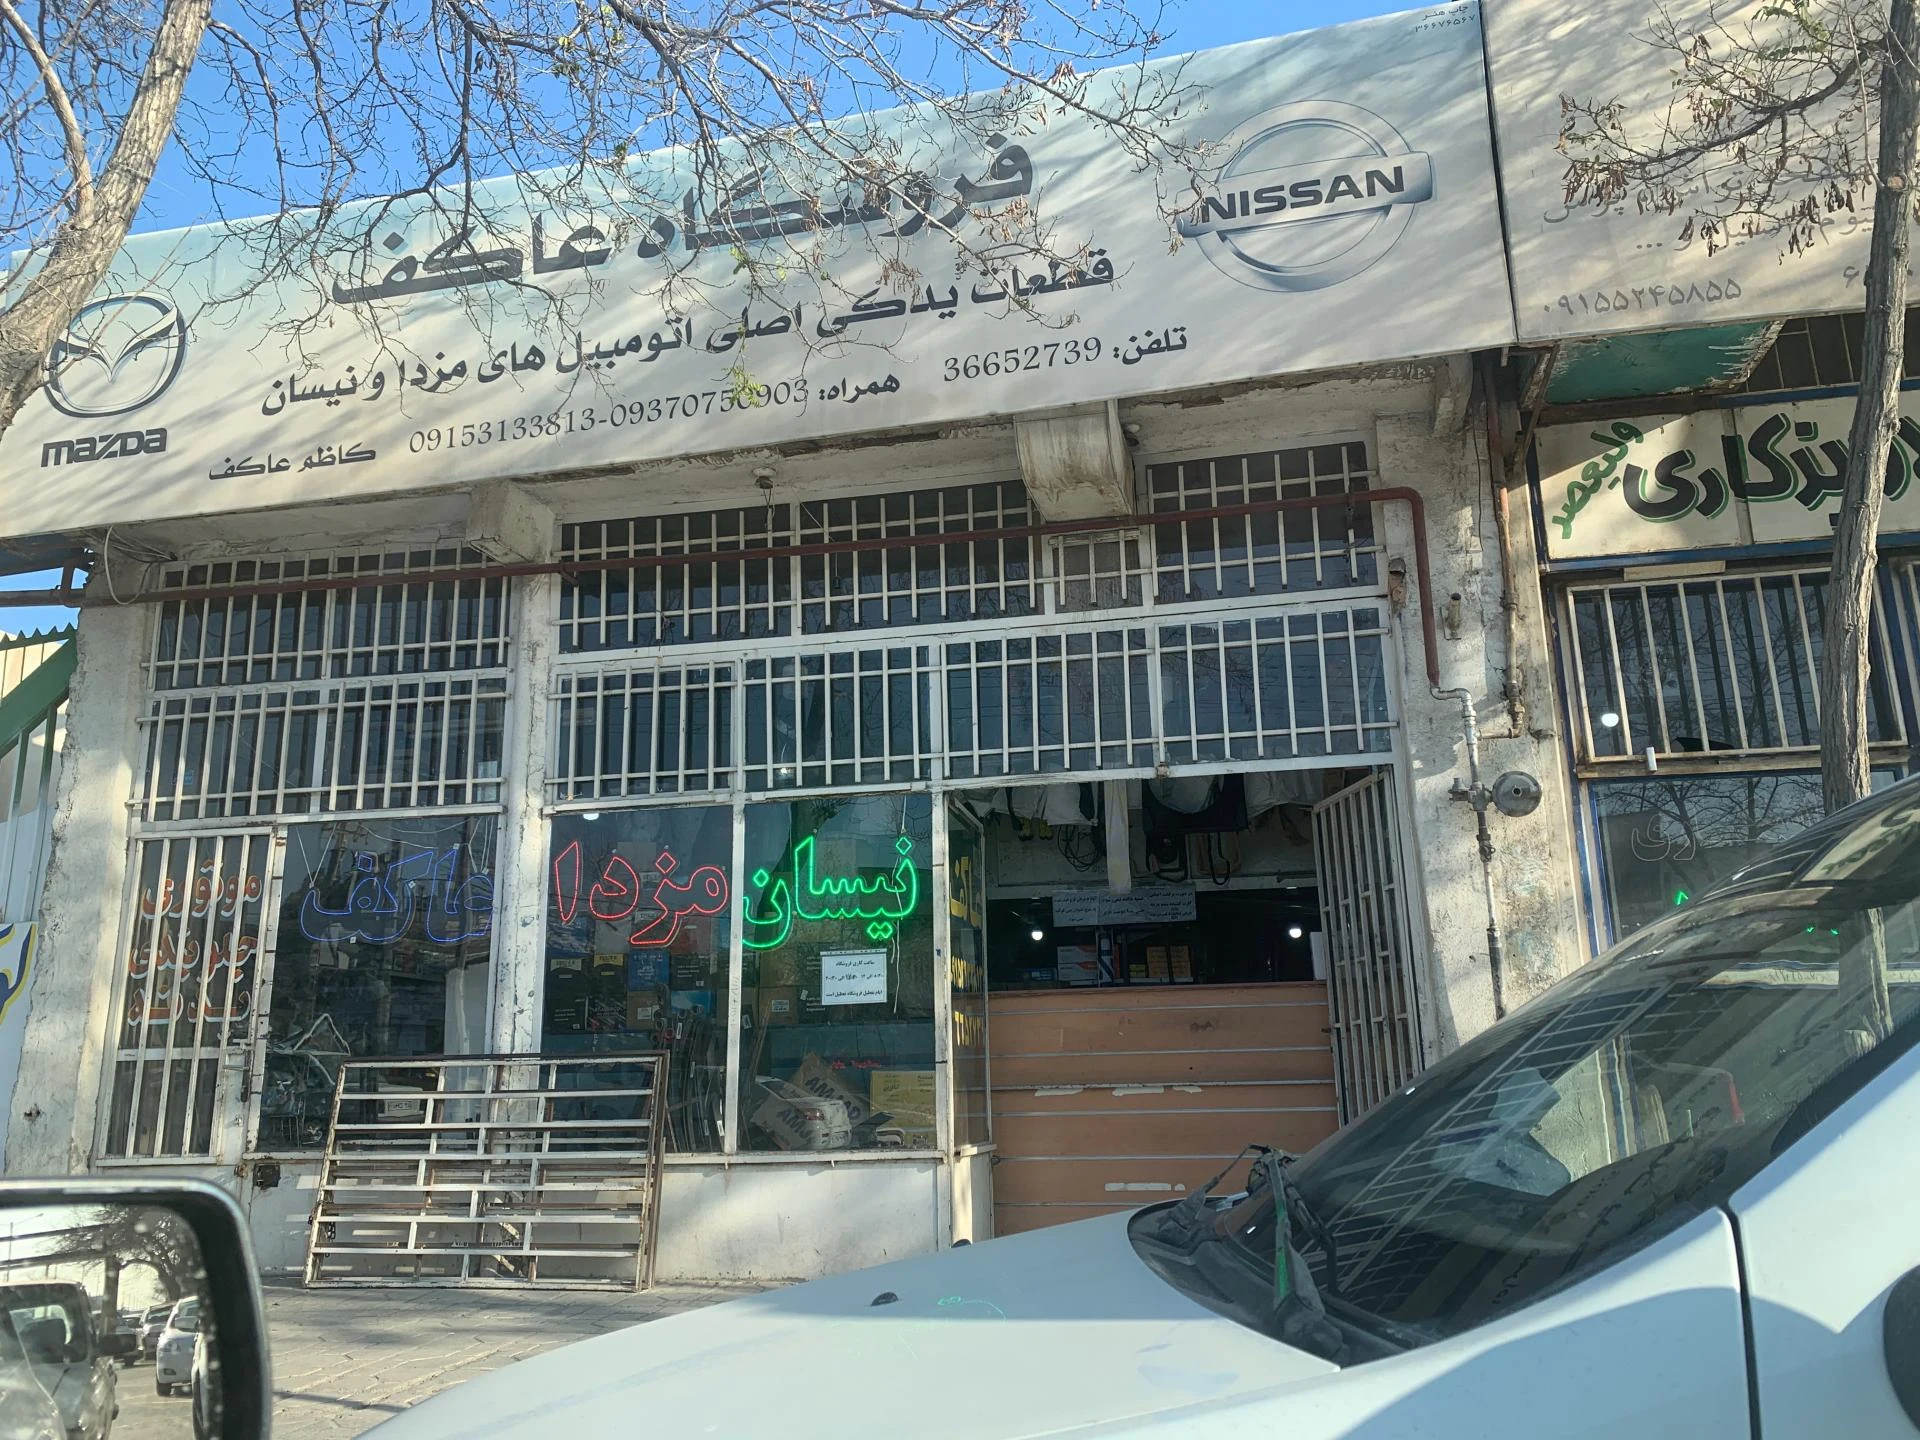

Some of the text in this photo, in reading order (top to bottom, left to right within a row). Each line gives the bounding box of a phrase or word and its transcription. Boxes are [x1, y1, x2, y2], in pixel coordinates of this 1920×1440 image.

[1201, 165, 1405, 224] NISSAN
[332, 212, 611, 304] عاکف
[1543, 277, 1742, 316] ۰۹۱۵۵۲۴۵۸۵۵
[261, 247, 1115, 416] قطعات یدکی اصلی اتومبیل های مزدا و نیسان
[943, 325, 1188, 382] تلفن: 36652739
[818, 373, 901, 404] همراه:
[208, 442, 377, 481] کاظم عاکف
[1552, 421, 1644, 539] ولیعصر
[300, 847, 495, 943] عاکف
[554, 840, 729, 946] مزدا
[742, 835, 919, 950] نیسان
